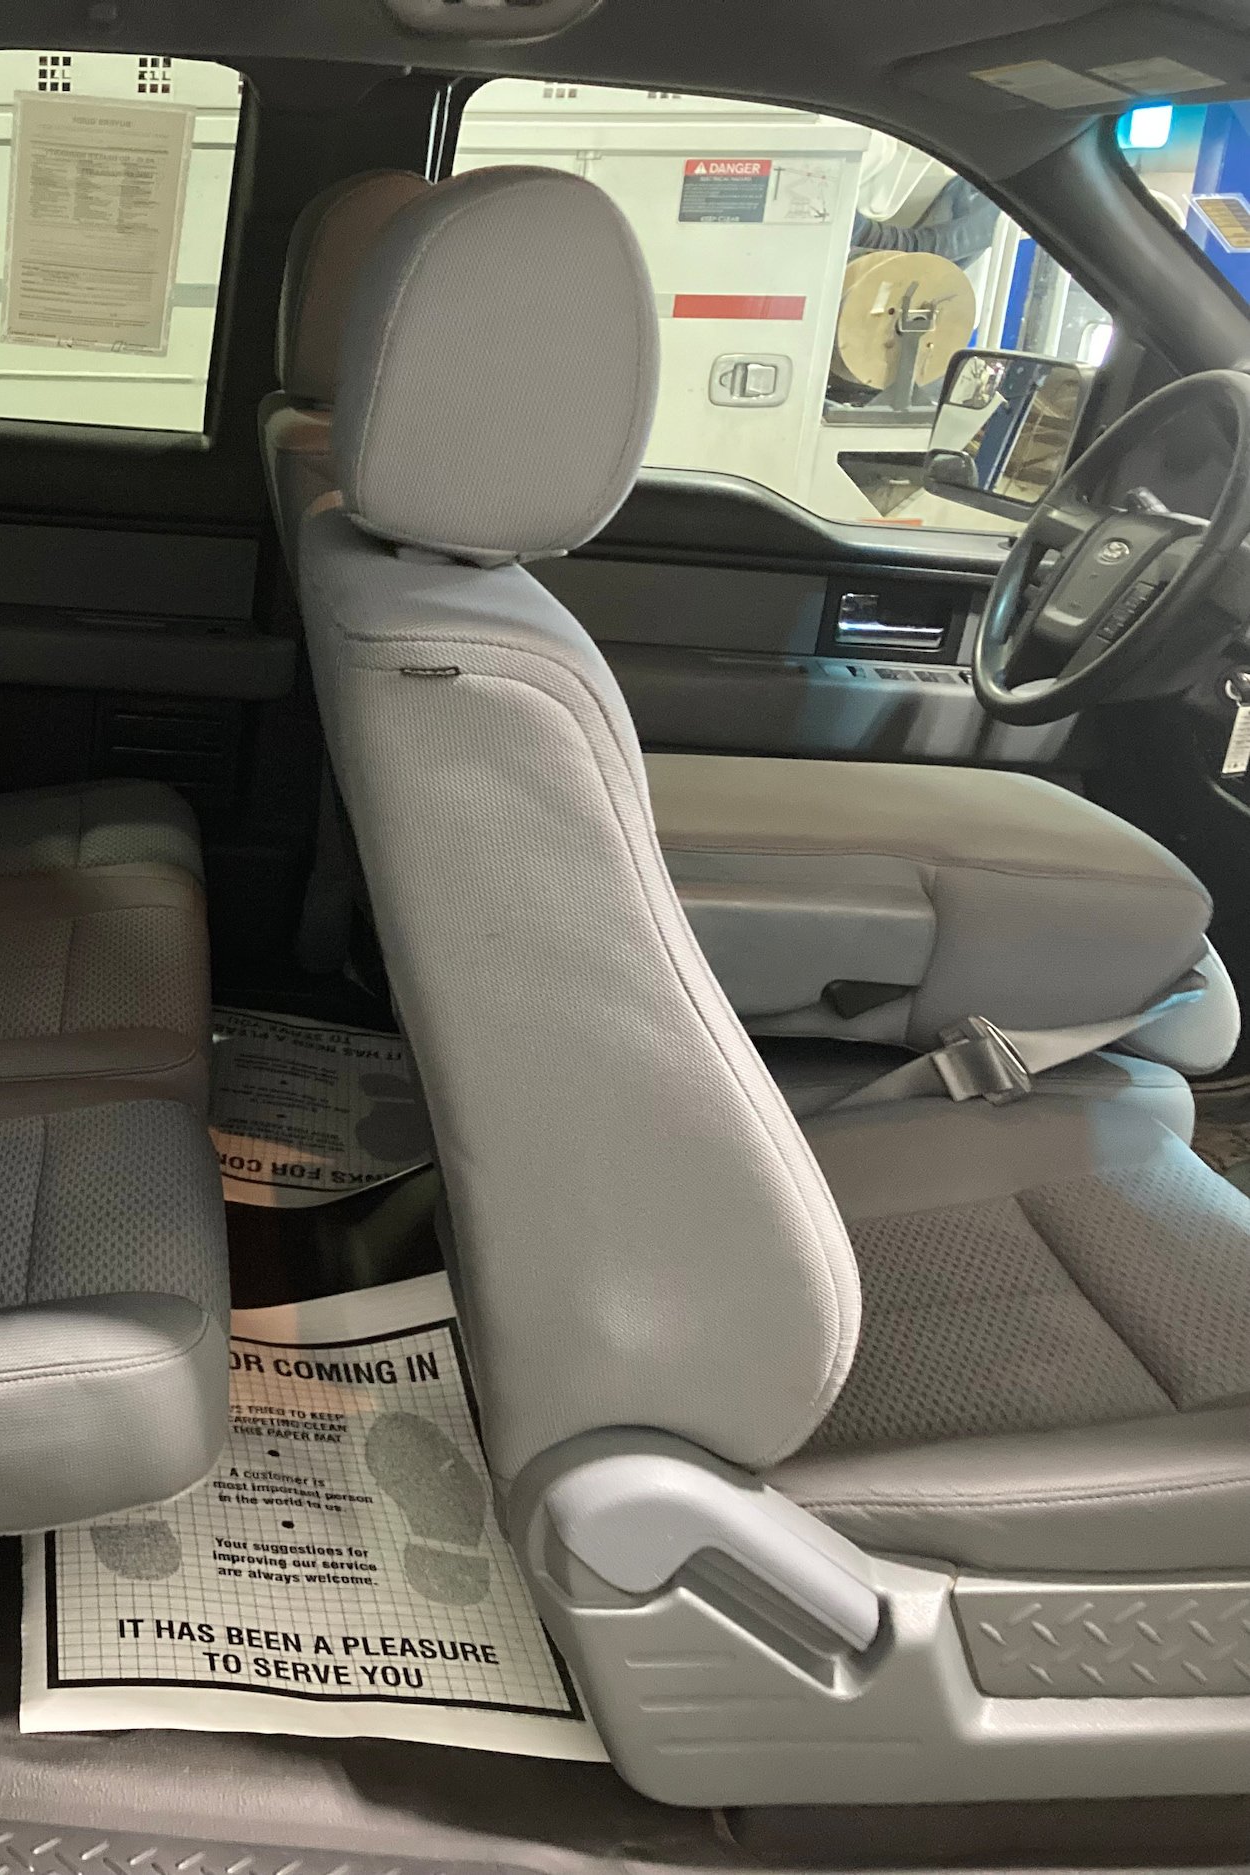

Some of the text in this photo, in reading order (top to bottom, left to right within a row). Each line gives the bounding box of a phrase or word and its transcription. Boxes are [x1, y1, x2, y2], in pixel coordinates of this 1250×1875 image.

[708, 162, 761, 175] DANGER
[271, 1161, 322, 1180] FOR
[273, 1358, 398, 1384] COMING
[406, 1351, 440, 1383] IN
[290, 1409, 306, 1419] TO
[310, 1412, 345, 1421] KEEP
[232, 1425, 342, 1443] THIS PAPER MAT
[304, 1421, 348, 1433] CLEAN
[229, 1467, 326, 1488] A customer is
[213, 1480, 374, 1505] most important person
[218, 1490, 232, 1503] in
[236, 1494, 259, 1506] the
[262, 1495, 303, 1507] world
[307, 1500, 322, 1510] to
[215, 1537, 369, 1558] Your suggestions for
[292, 1557, 317, 1569] our
[322, 1560, 378, 1572] service
[218, 1566, 379, 1586] are always welcome.
[117, 1618, 501, 1666] IT HAS BEEN A PLEASURE
[202, 1651, 426, 1690] TO SERVE YOU
